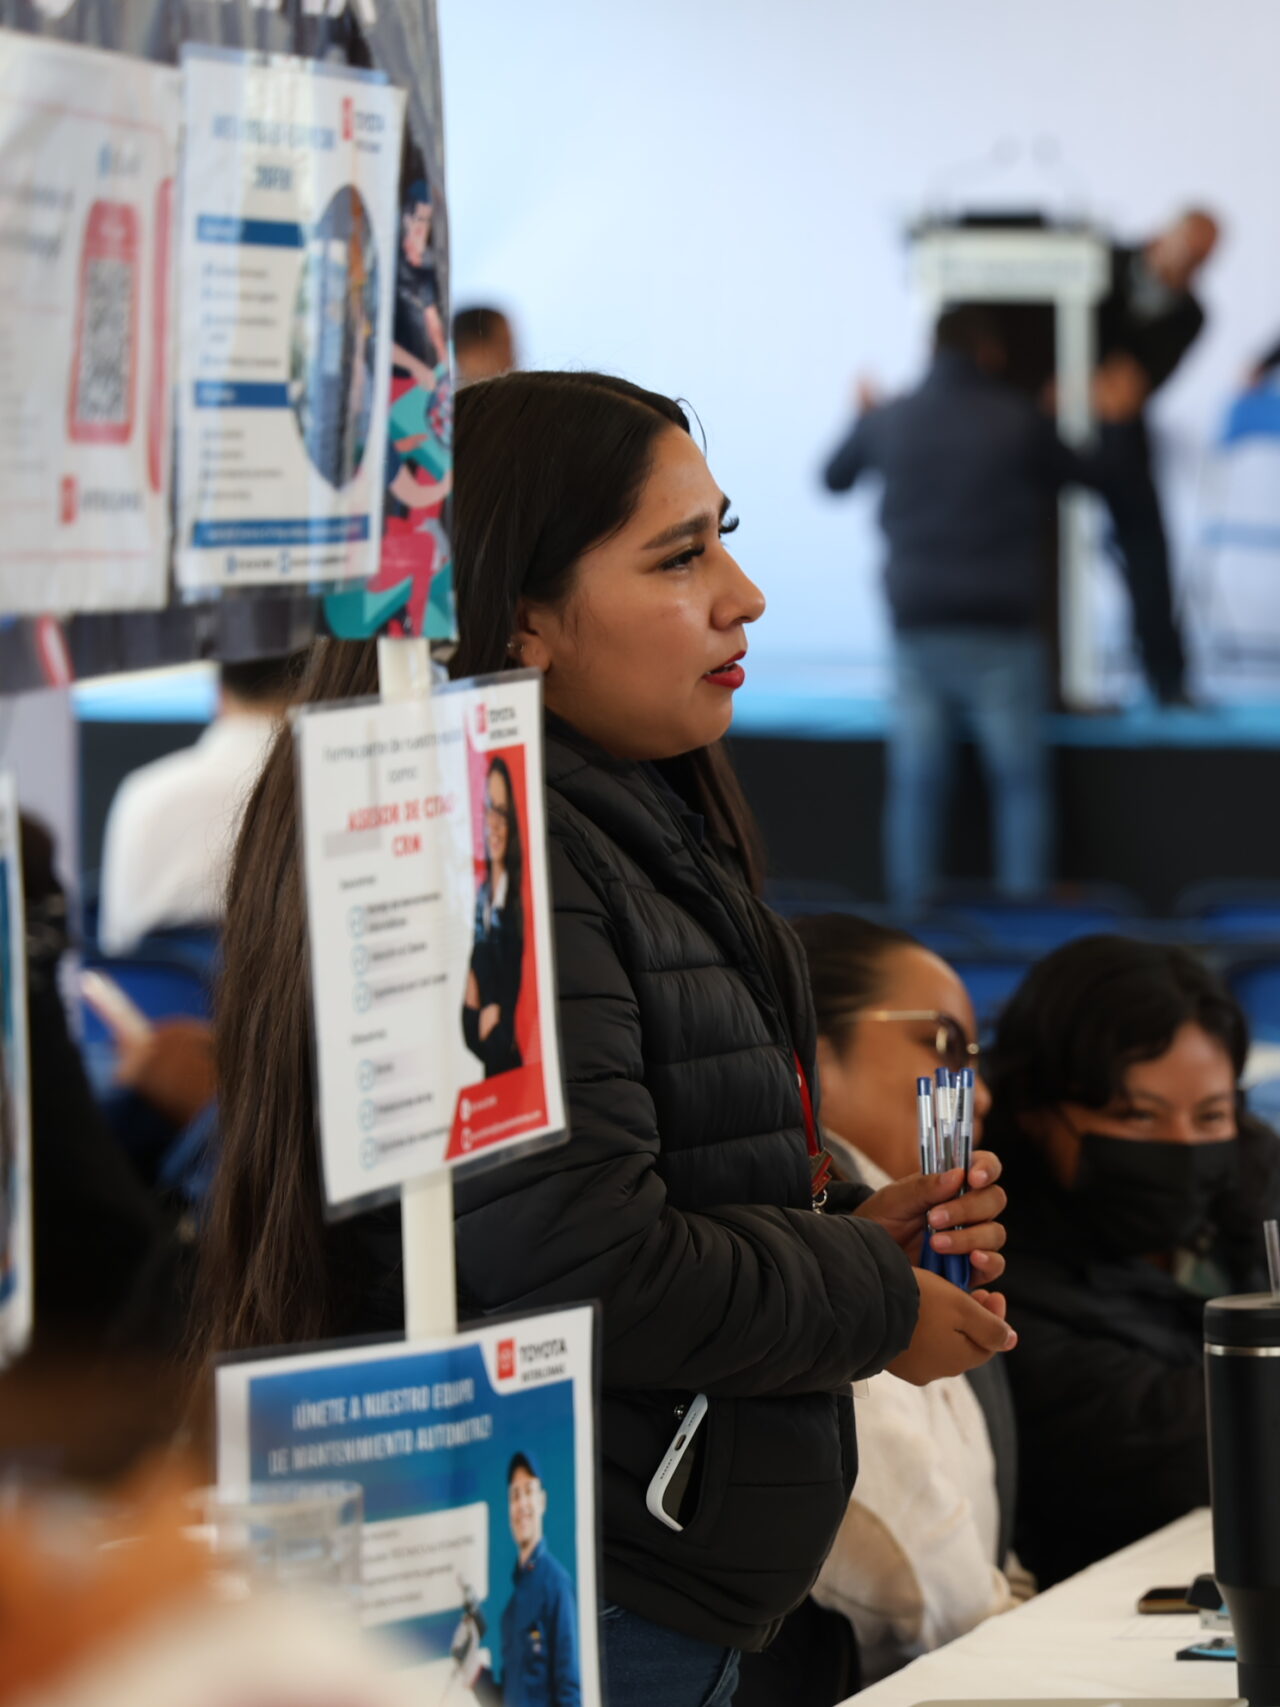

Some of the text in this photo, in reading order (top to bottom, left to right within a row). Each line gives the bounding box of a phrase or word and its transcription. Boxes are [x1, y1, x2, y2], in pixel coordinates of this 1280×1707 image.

[404, 799, 420, 822] DE
[520, 1338, 567, 1364] TOYOTA
[348, 1394, 362, 1420] A
[363, 1384, 431, 1418] NUESTRO
[267, 1448, 289, 1476] DE
[292, 1428, 414, 1471] MANTENIMIENTO
